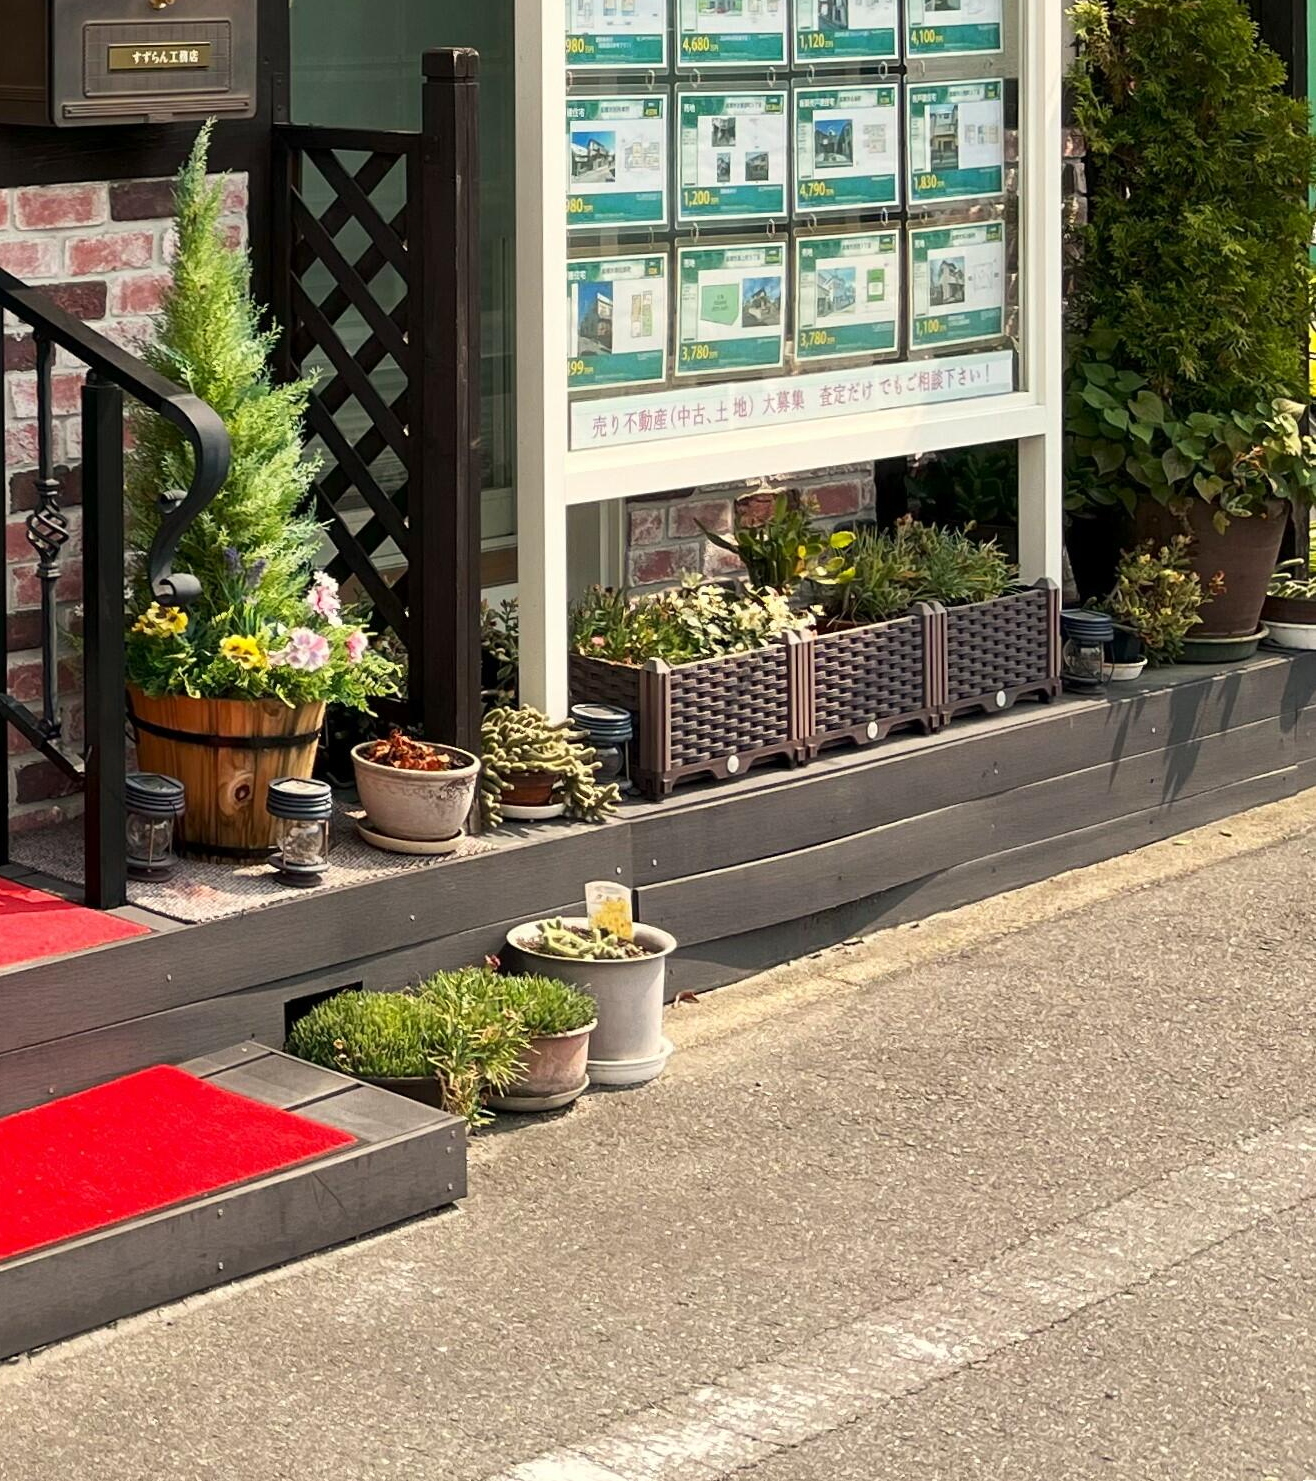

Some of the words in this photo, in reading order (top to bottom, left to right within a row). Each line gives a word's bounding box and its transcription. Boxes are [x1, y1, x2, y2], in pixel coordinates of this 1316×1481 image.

[132, 49, 199, 65] すずらん工務店
[763, 388, 805, 417] 大募集
